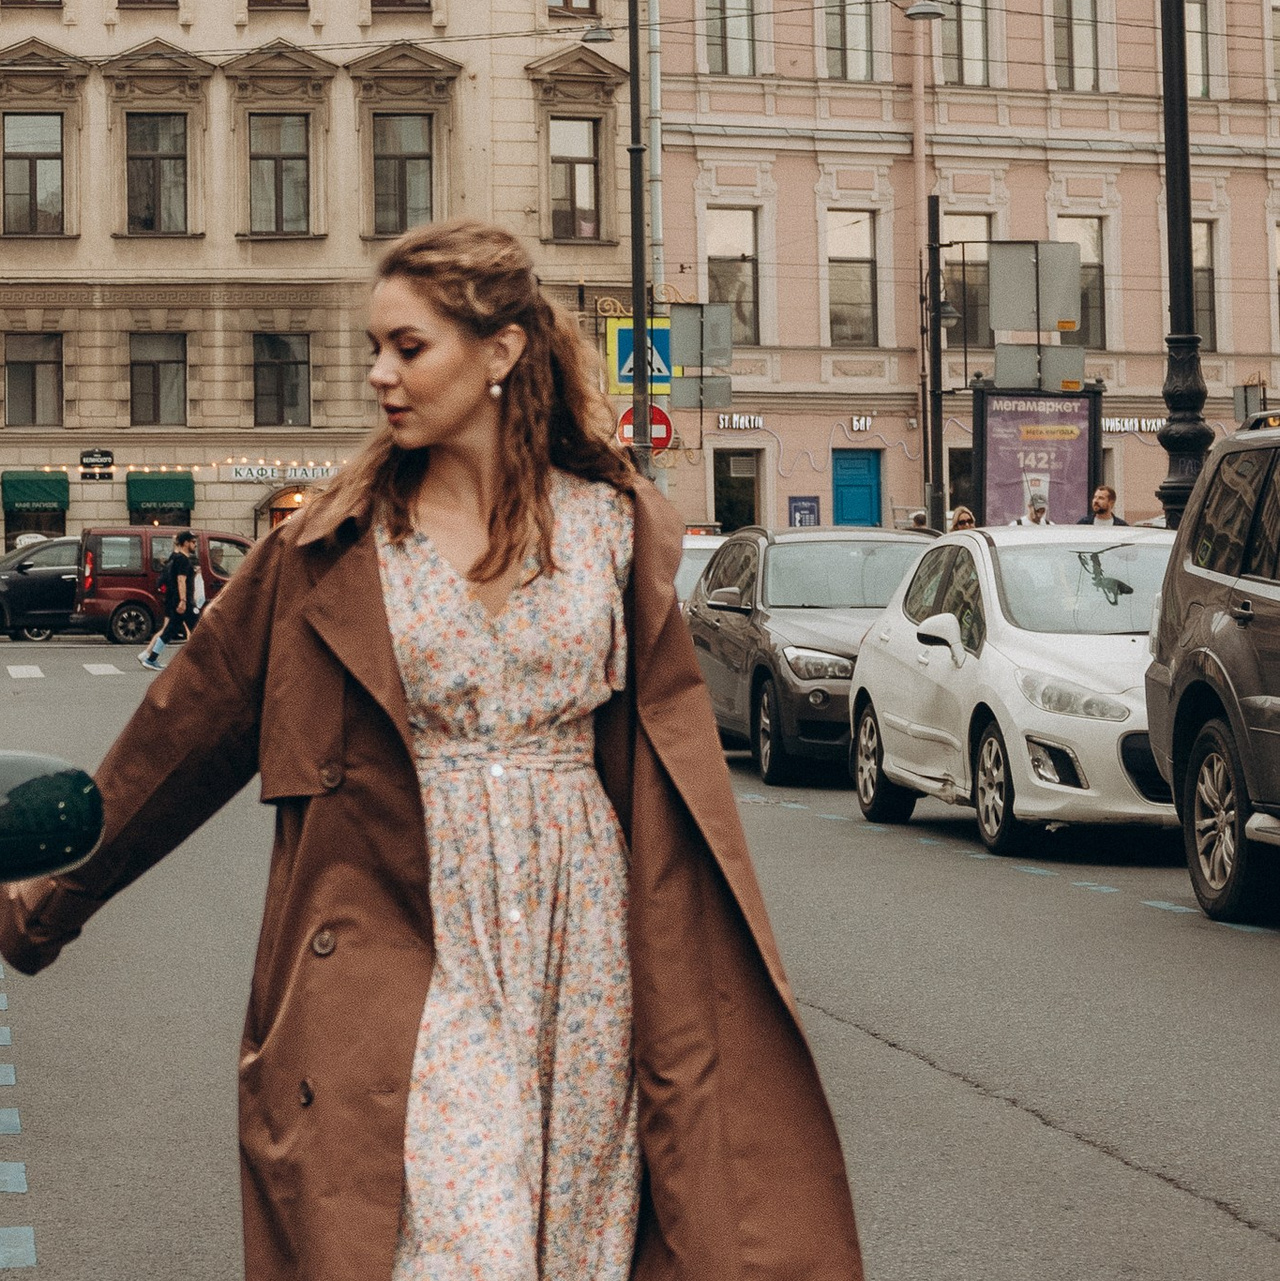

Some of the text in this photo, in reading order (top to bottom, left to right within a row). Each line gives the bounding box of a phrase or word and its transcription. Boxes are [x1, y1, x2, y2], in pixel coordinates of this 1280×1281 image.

[992, 400, 1081, 414] мегамаркет
[852, 416, 872, 431] БАР
[1017, 452, 1049, 469] 142
[234, 467, 277, 478] КАФЕ
